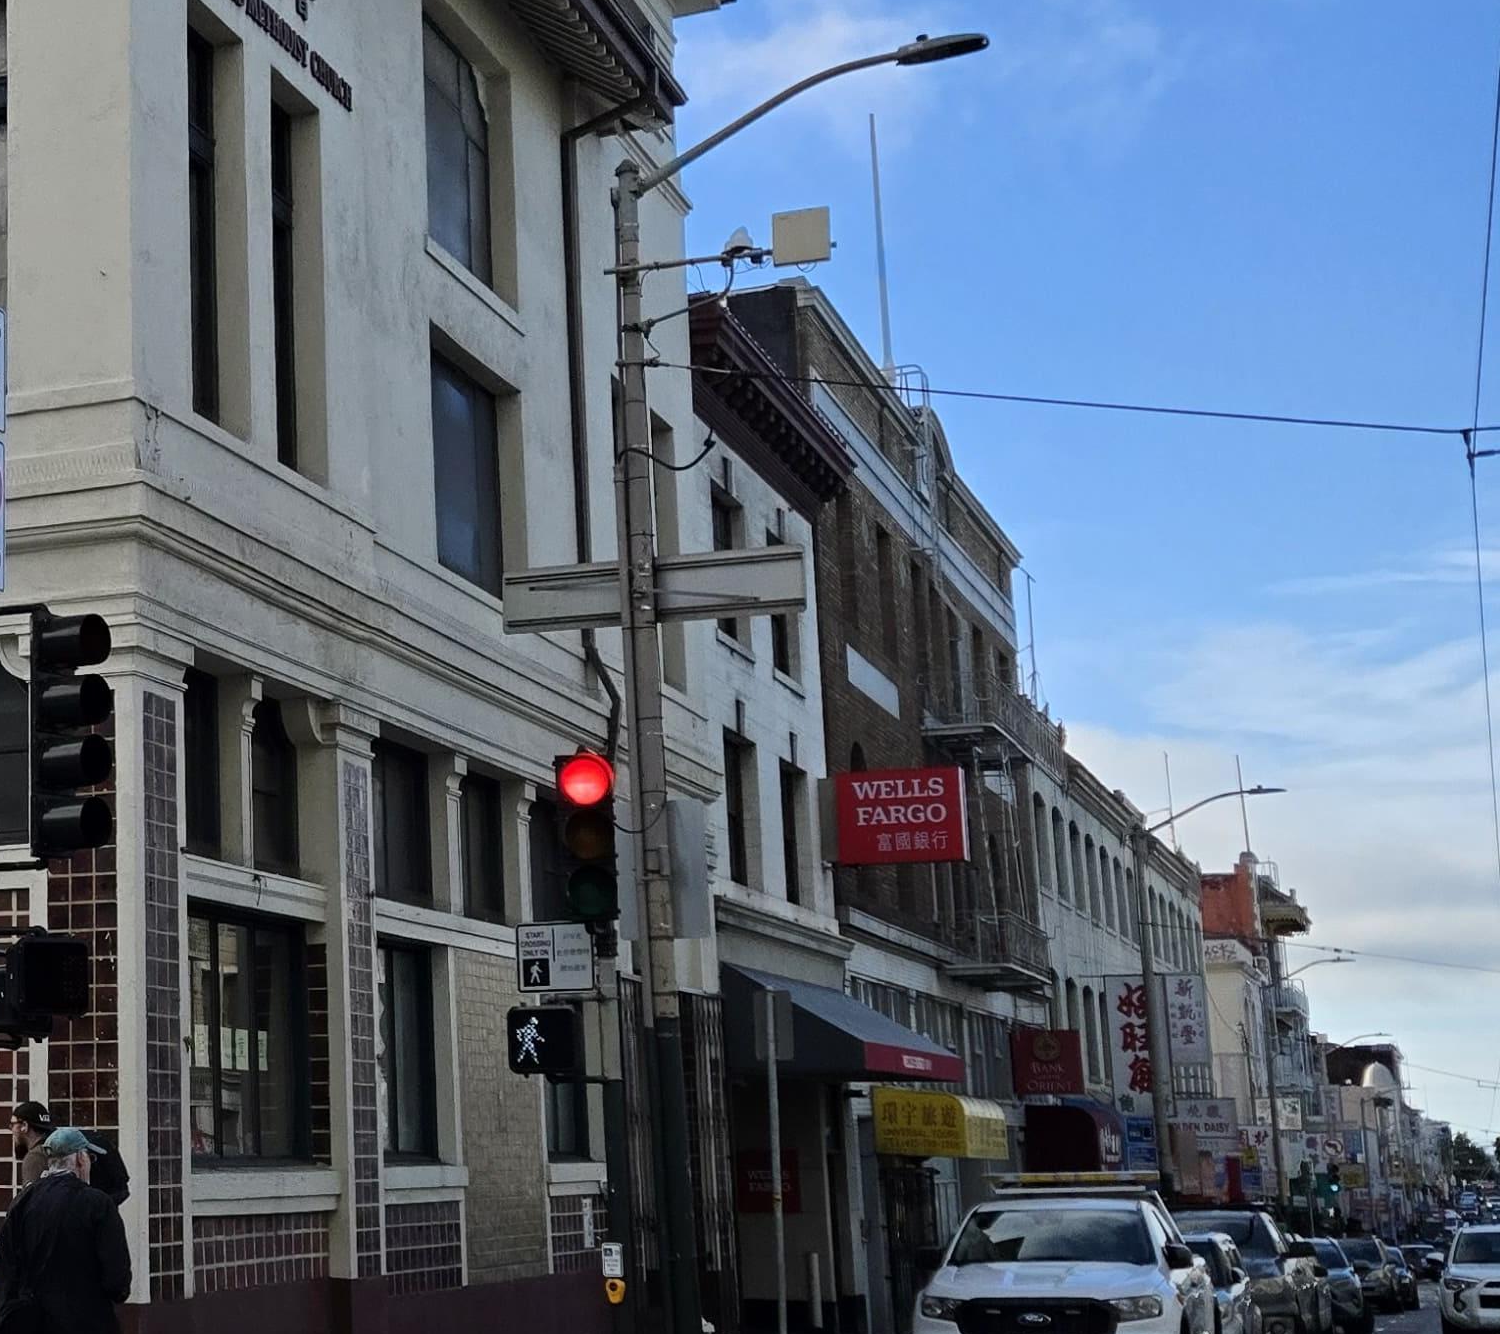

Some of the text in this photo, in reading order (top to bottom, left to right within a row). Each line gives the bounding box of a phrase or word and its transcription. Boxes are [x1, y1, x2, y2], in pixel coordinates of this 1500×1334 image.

[309, 50, 353, 112] CHURCH
[851, 777, 945, 801] WELLS
[856, 803, 947, 826] FARGO
[876, 830, 949, 852] 富國銀行
[525, 931, 545, 939] START
[521, 940, 551, 948] CROSSING
[1030, 1062, 1066, 1075] BANK
[1027, 1079, 1073, 1092] ORIENT
[1204, 1123, 1230, 1134] DAISY
